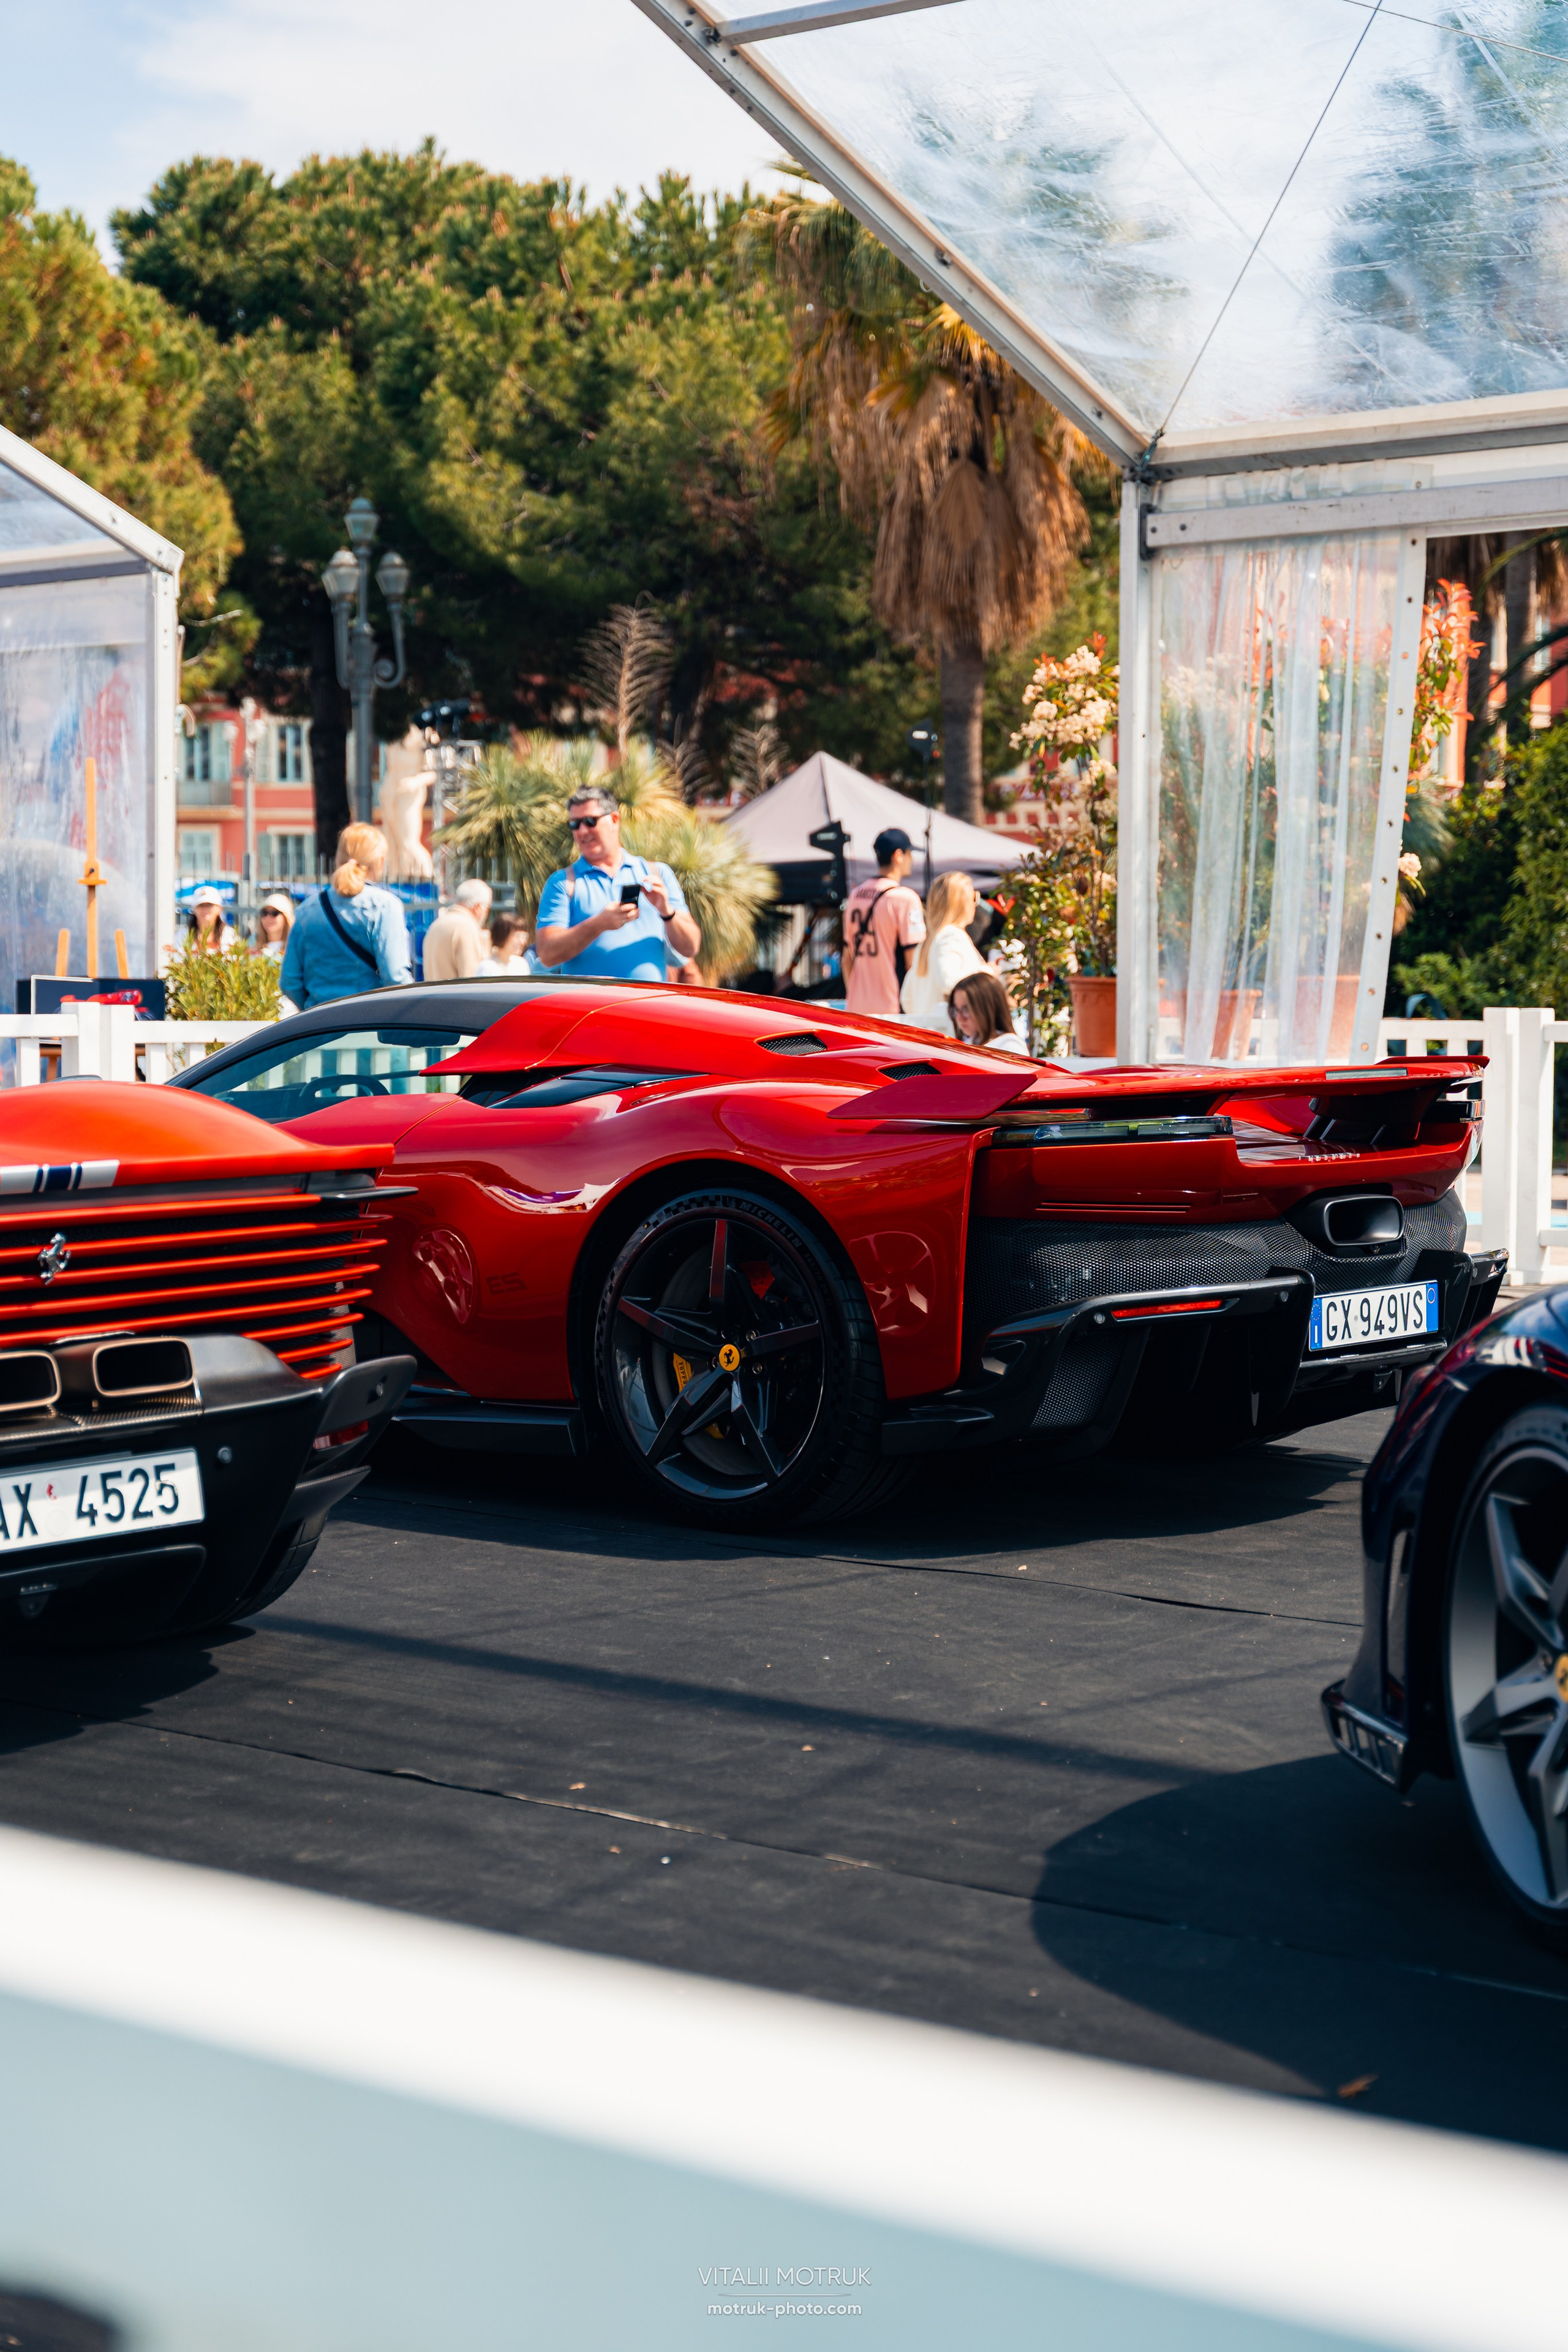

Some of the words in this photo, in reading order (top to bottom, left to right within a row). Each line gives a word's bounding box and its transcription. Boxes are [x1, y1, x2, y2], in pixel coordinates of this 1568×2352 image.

[739, 1201, 803, 1248] MICHELIN
[1327, 1299, 1352, 1341] GX
[1360, 1290, 1423, 1336] 949VS
[76, 1463, 179, 1526] 4525
